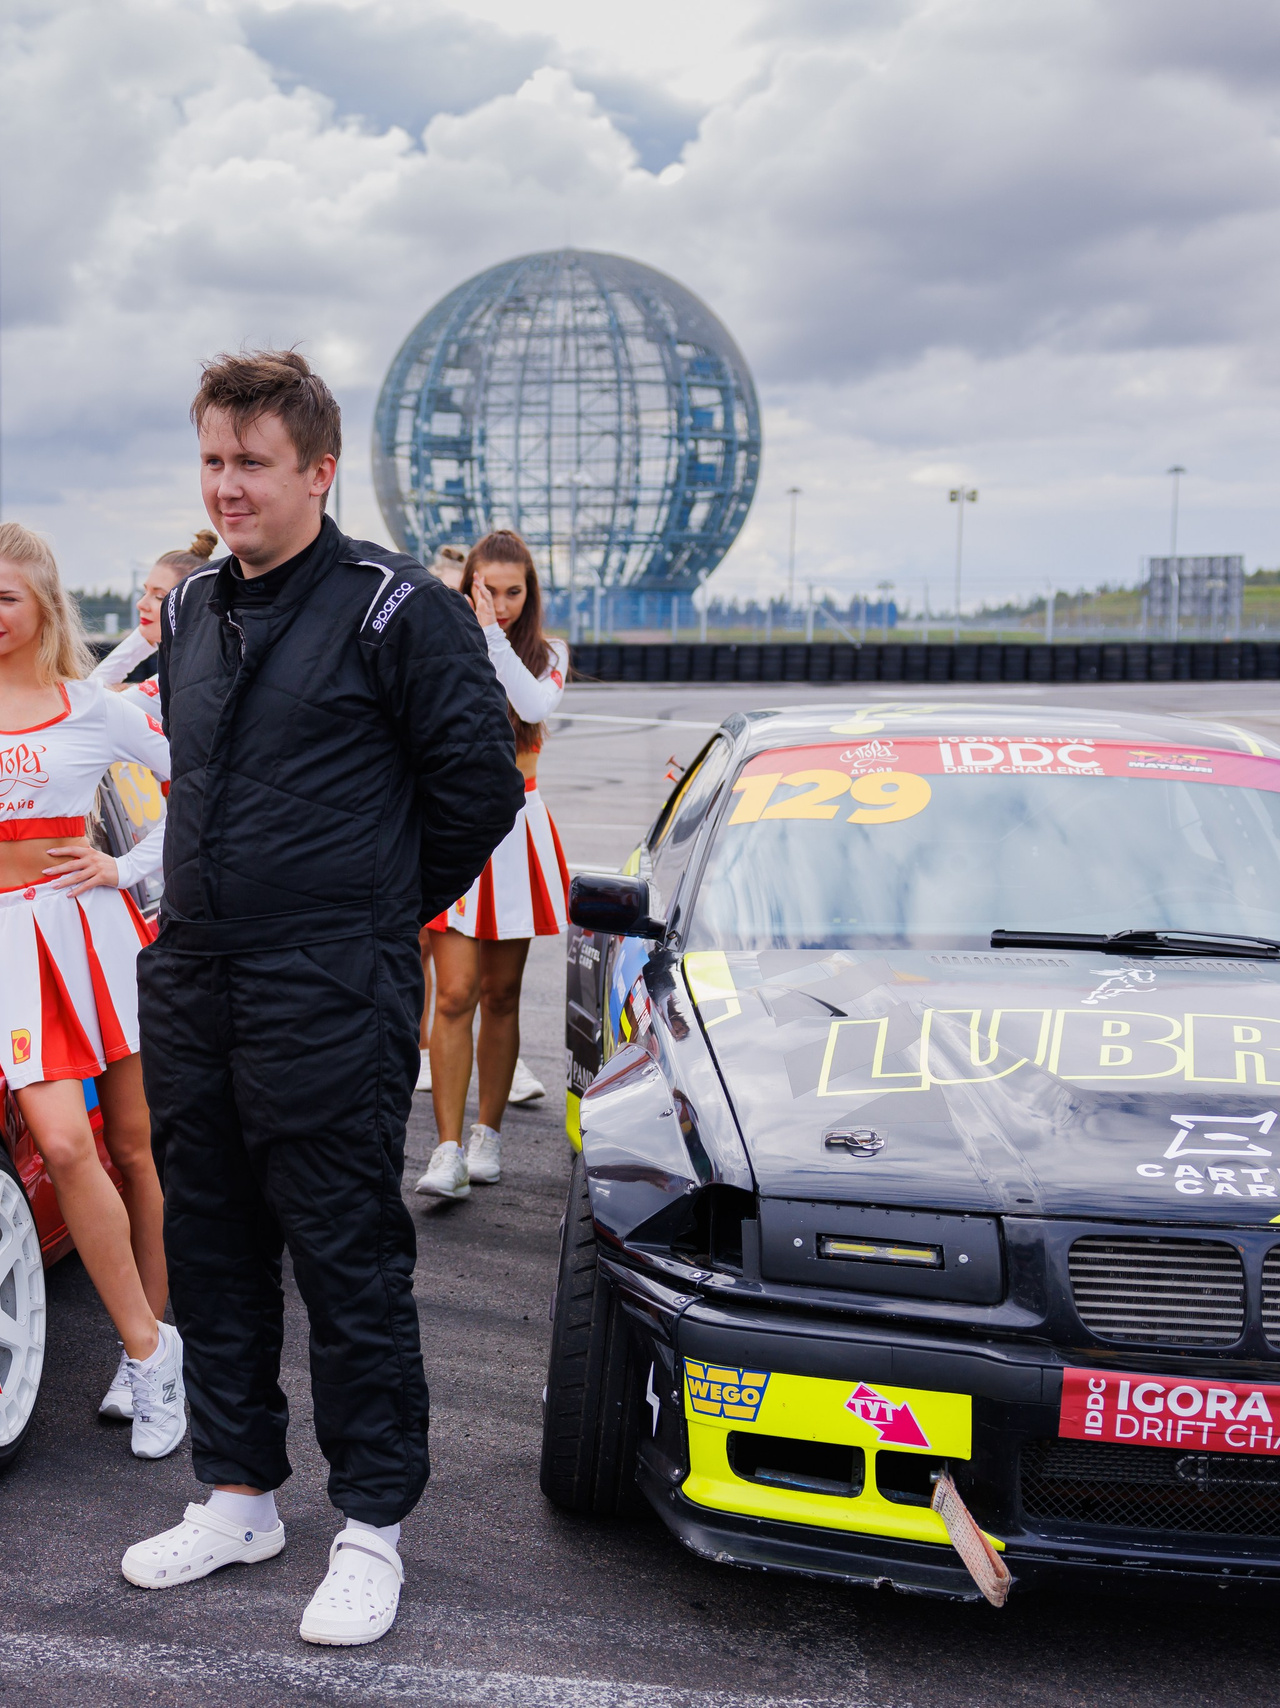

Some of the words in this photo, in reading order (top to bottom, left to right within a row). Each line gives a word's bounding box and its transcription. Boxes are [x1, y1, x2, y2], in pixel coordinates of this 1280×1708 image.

[372, 582, 412, 630] sparco
[938, 736, 1011, 744] IGORA
[1023, 736, 1095, 745] DRIVE
[939, 742, 1101, 768] IDDC
[943, 765, 996, 774] DRIFT
[998, 765, 1106, 776] CHALLENGE
[1128, 761, 1213, 773] MATSURI
[727, 768, 932, 826] 129
[1136, 1163, 1280, 1183] CART
[688, 1377, 761, 1406] WEGO
[1117, 1379, 1274, 1424] IGORA
[1084, 1377, 1107, 1436] IDDC
[1115, 1413, 1217, 1445] DRIFT
[1224, 1424, 1280, 1450] CH
